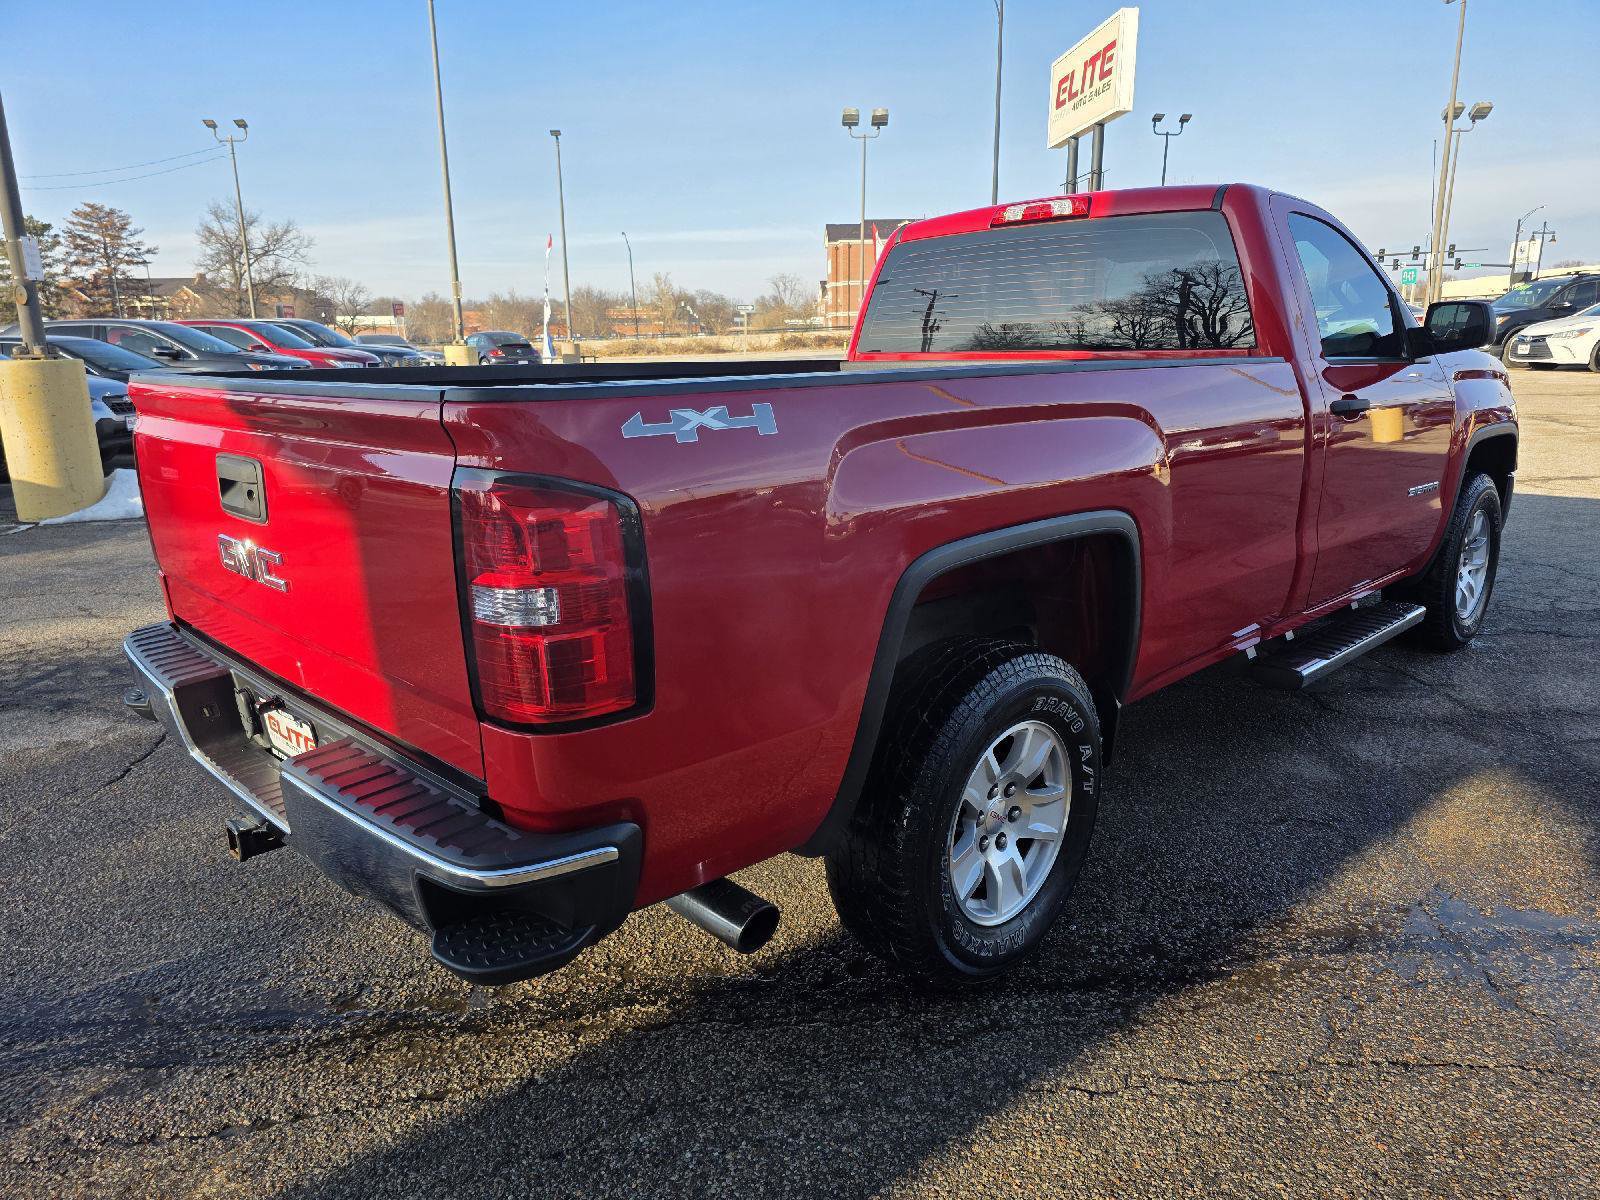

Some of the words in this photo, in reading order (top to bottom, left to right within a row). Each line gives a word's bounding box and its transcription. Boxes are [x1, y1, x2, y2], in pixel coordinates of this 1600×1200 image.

[1055, 39, 1117, 110] ELITE
[1071, 95, 1087, 111] AUTO
[1087, 80, 1112, 102] SALES
[217, 533, 289, 592] GMC
[1031, 696, 1084, 733] BRAVO
[1080, 745, 1094, 794] A/T
[989, 809, 1007, 824] GMC
[952, 920, 1025, 957] MAXXIS
